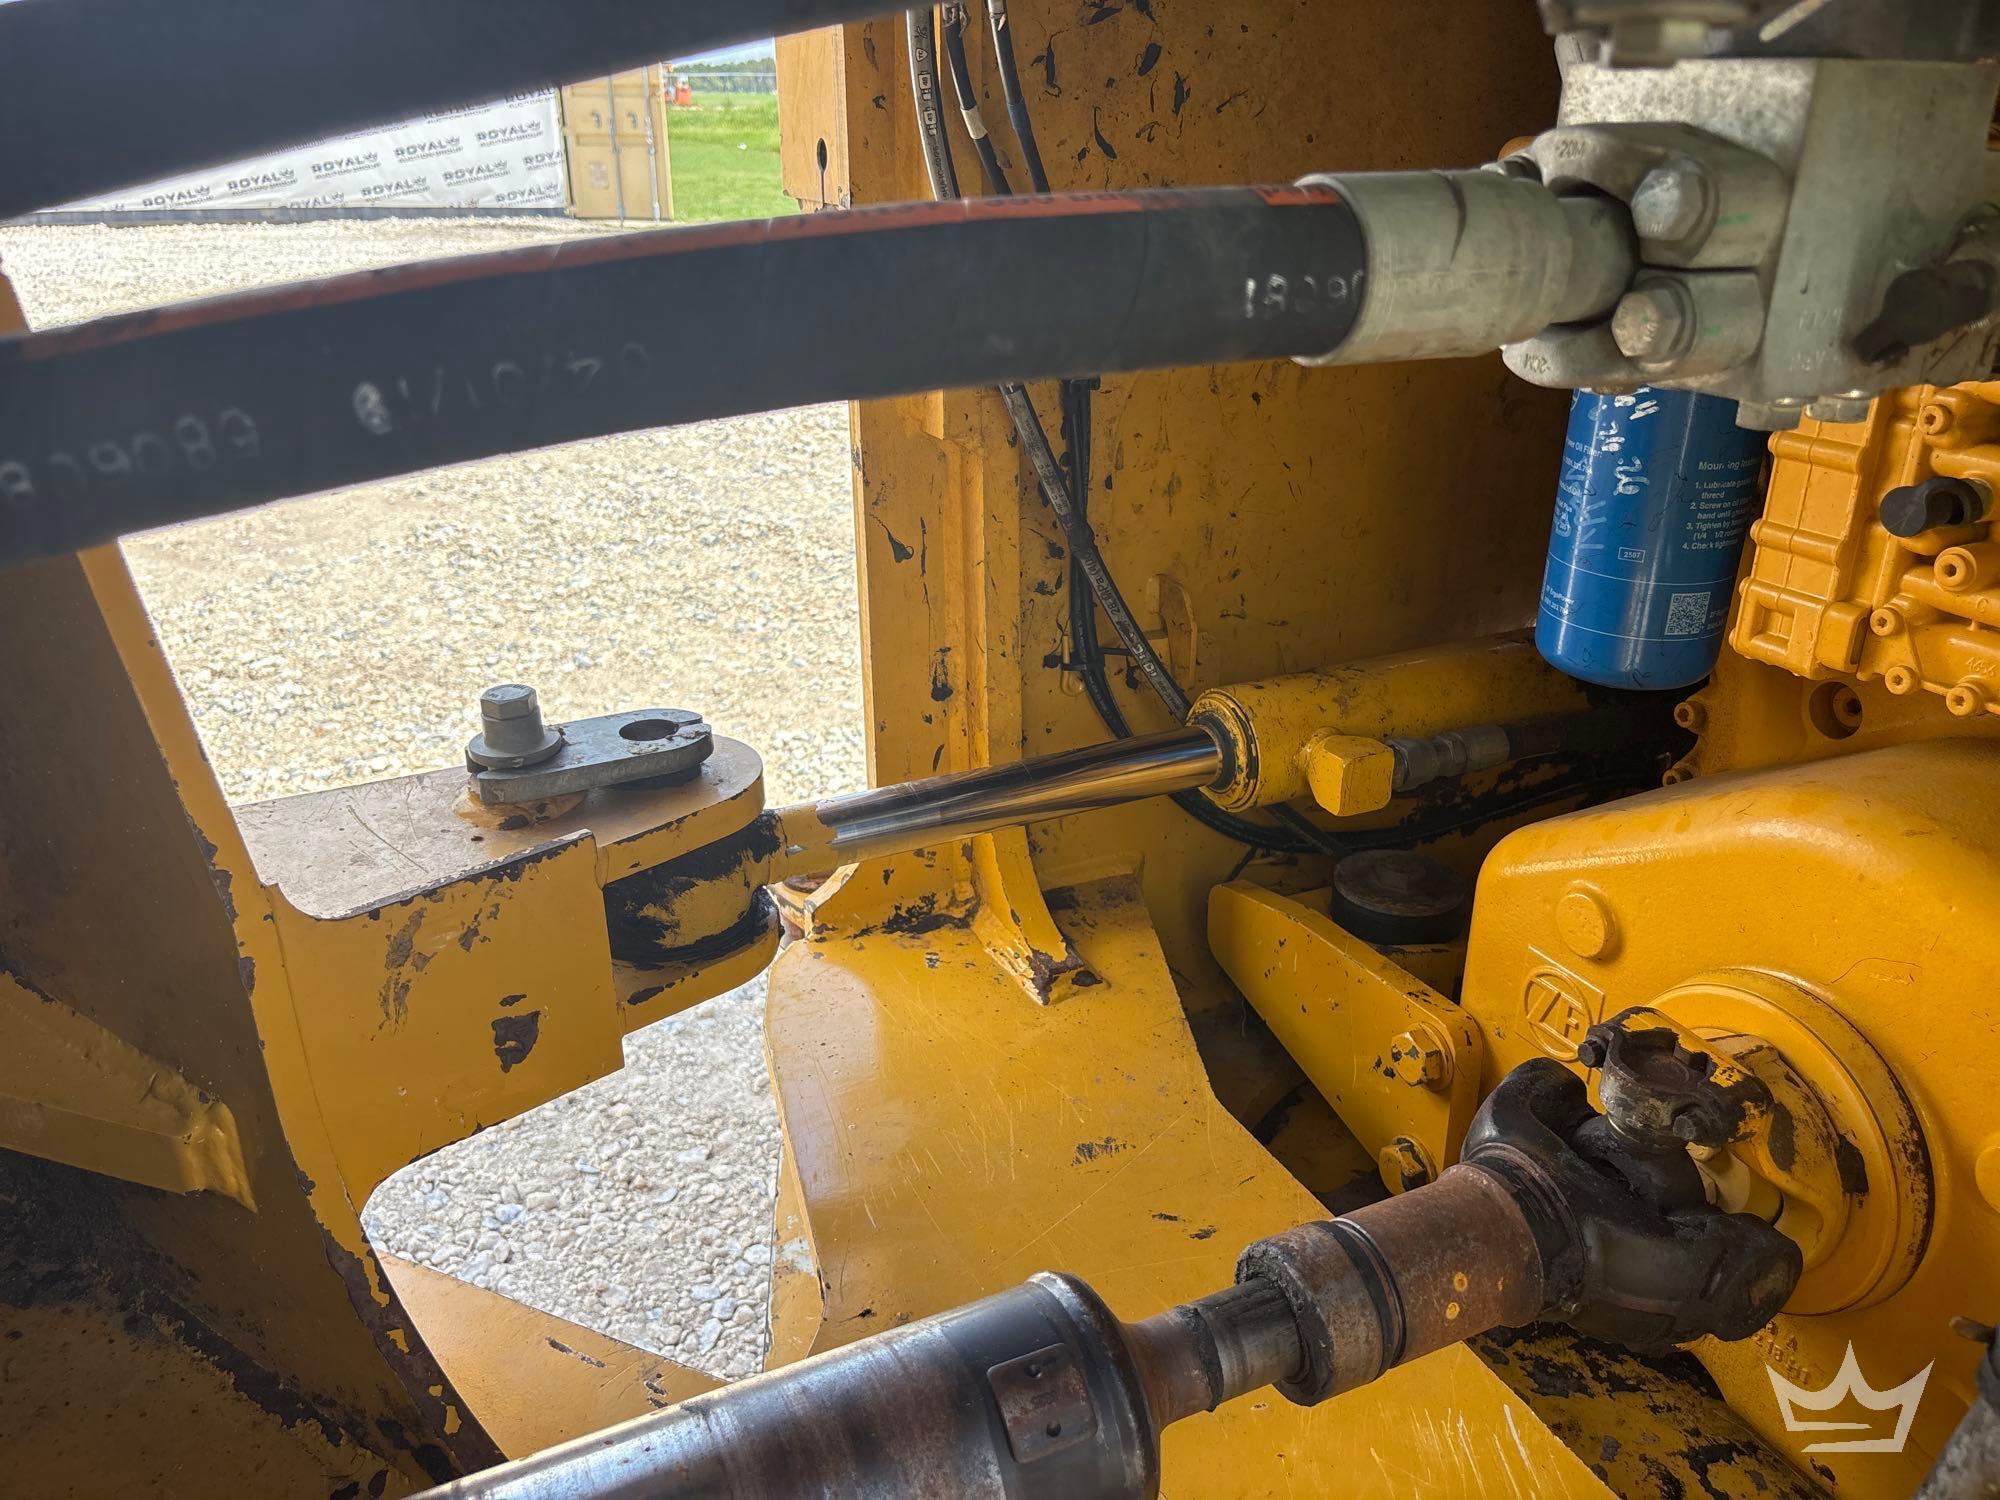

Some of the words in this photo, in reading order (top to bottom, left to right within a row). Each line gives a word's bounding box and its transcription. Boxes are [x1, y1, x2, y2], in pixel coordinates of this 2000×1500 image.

[476, 124, 529, 142] ROYAL
[395, 139, 447, 158] ROYAL
[311, 155, 365, 173] ROYAL
[442, 164, 495, 182] ROYAL
[226, 170, 280, 190] ROYAL
[361, 179, 413, 197] ROYAL
[142, 189, 197, 207] ROYAL
[495, 184, 546, 203] ROYAL
[1690, 502, 1697, 510] 2.
[1699, 501, 1721, 510] Screw
[1686, 522, 1693, 530] 3.
[1682, 542, 1689, 550] 4.
[1691, 541, 1714, 550] Check
